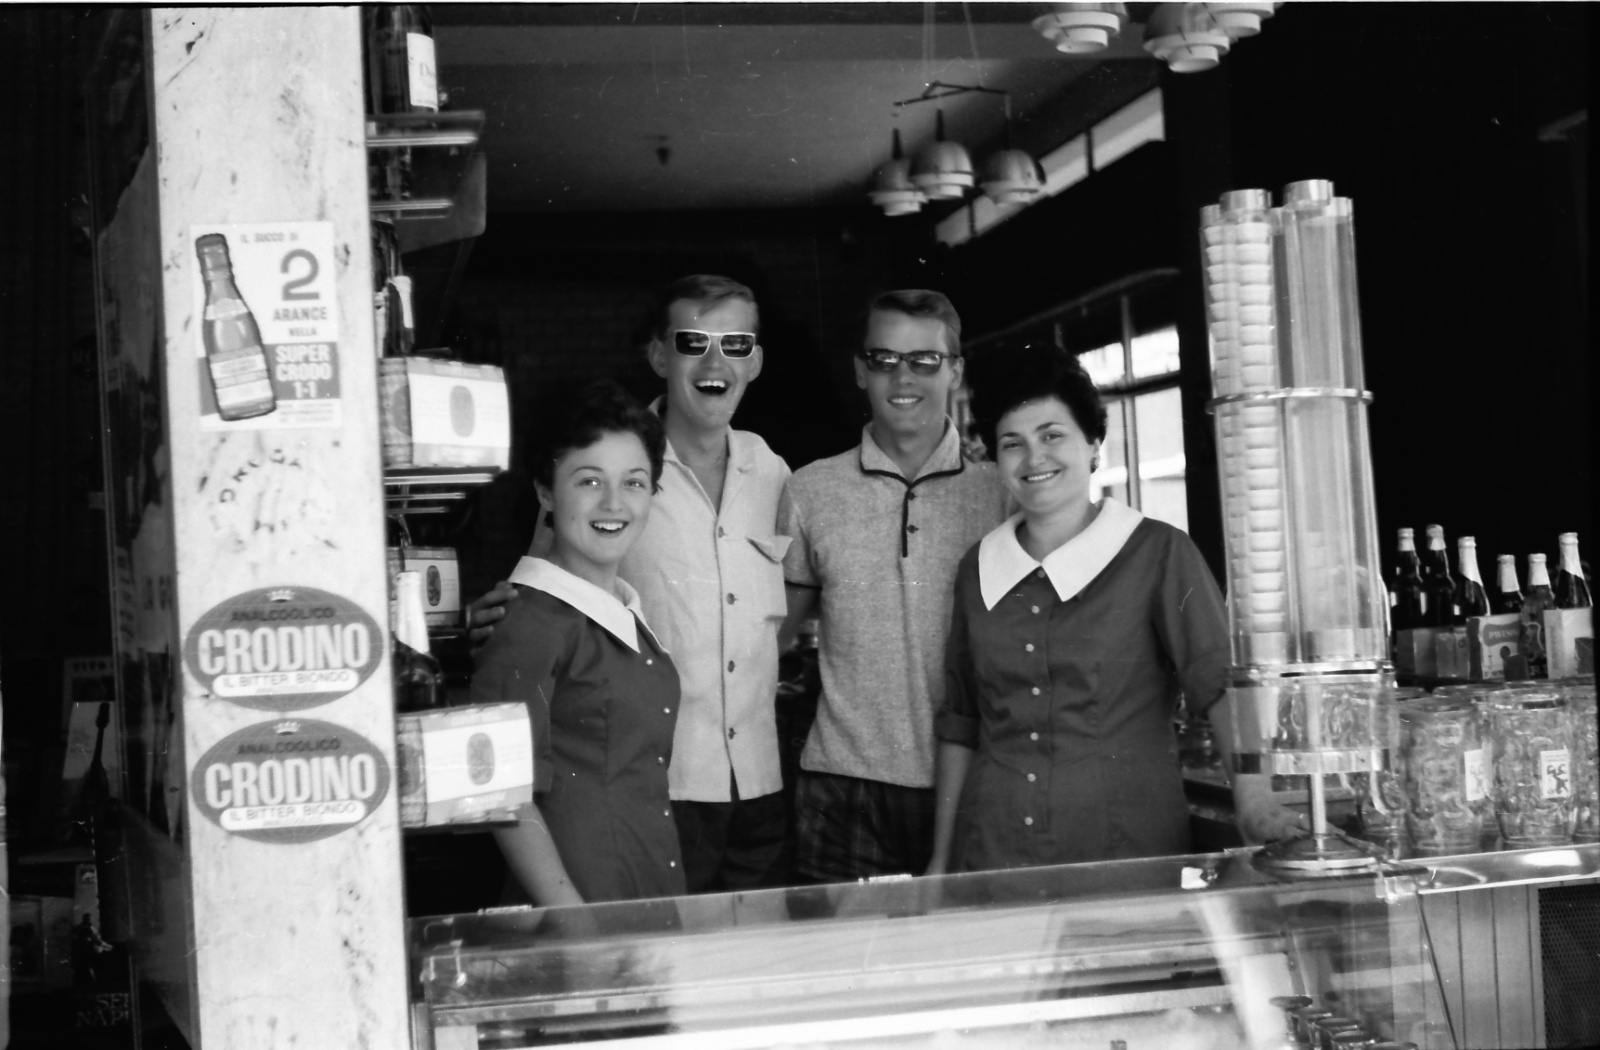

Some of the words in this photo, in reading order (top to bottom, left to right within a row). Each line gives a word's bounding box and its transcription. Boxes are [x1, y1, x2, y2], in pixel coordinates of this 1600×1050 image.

[254, 232, 285, 243] SUCCO
[280, 248, 320, 301] 2
[273, 306, 328, 322] ARANCE
[275, 344, 330, 363] SUPER
[275, 362, 333, 382] CRODO
[231, 606, 335, 622] ANALCOOLICO
[198, 622, 371, 675] CRODINO
[222, 677, 235, 688] IL
[239, 673, 288, 687] BITTER
[296, 670, 349, 684] BIONDO
[205, 753, 377, 809] CRODINO
[229, 810, 241, 821] IL
[246, 805, 295, 820] BITTER
[303, 802, 356, 816] BIONDO
